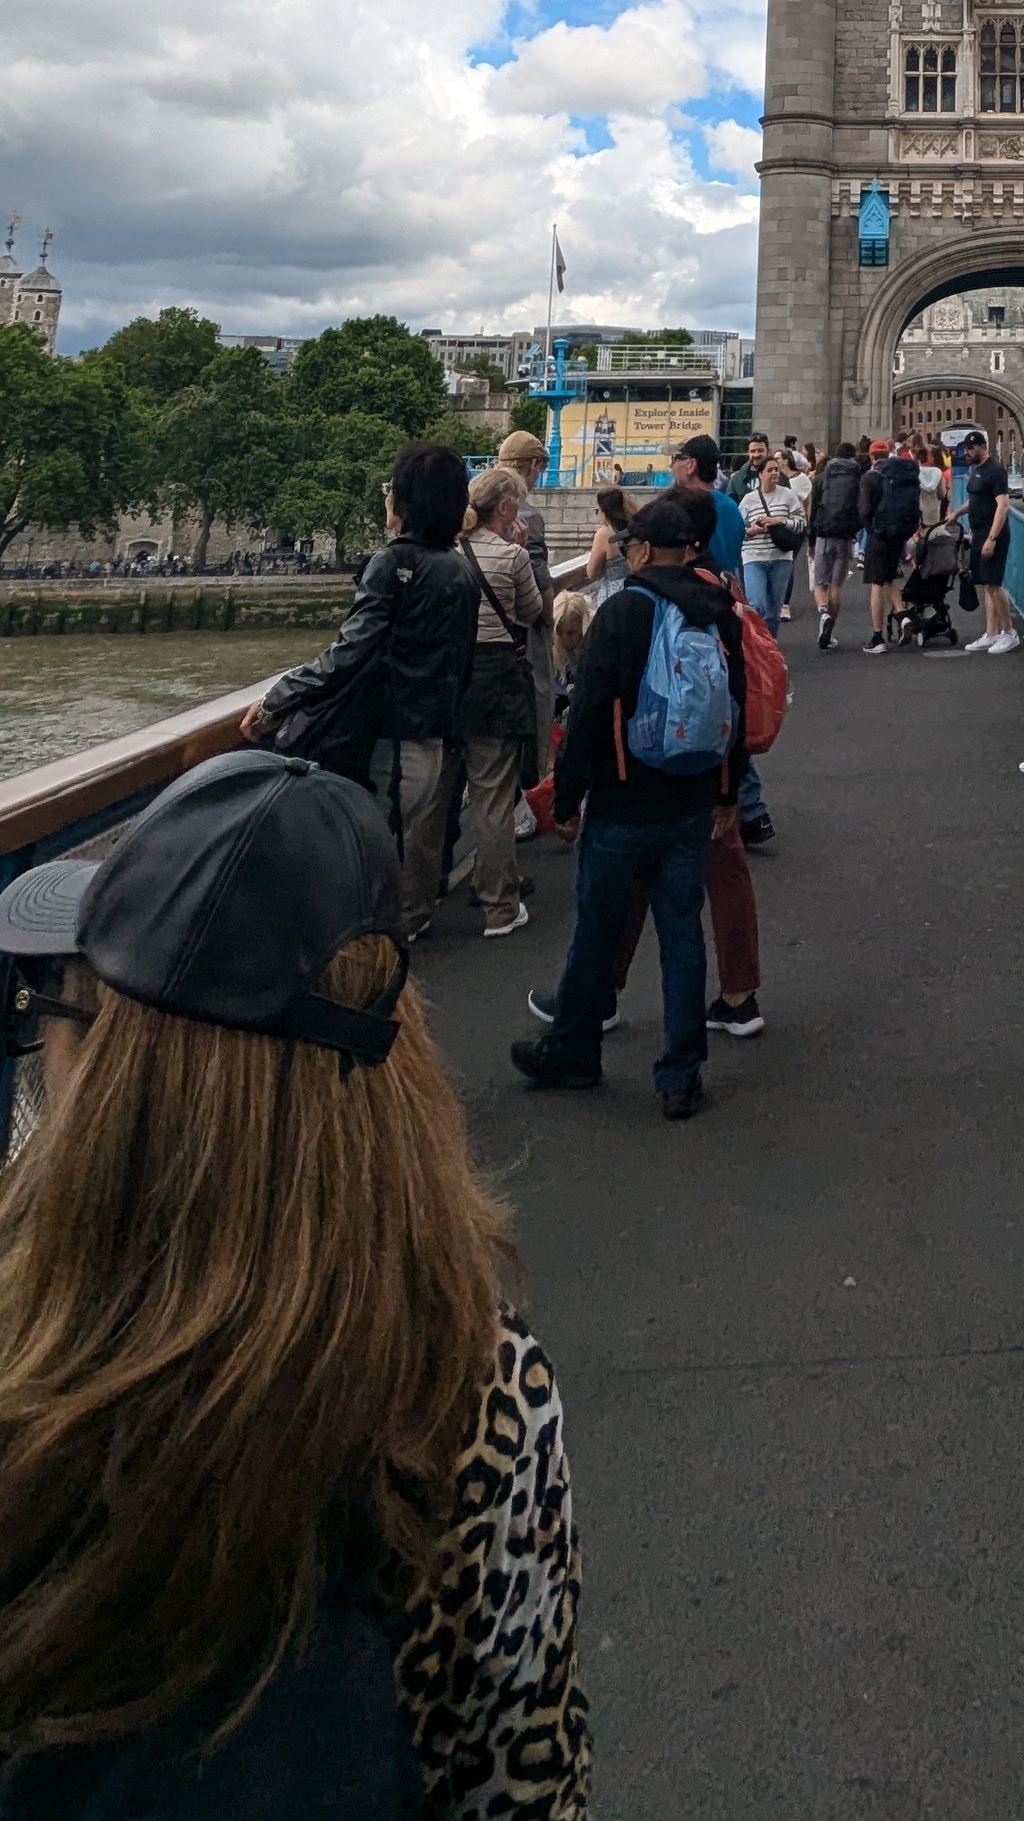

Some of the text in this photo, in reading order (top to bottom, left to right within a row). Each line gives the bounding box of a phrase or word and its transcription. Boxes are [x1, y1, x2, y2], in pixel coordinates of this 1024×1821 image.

[634, 408, 710, 419] Explore Inside
[634, 421, 703, 431] Tower Bridge
